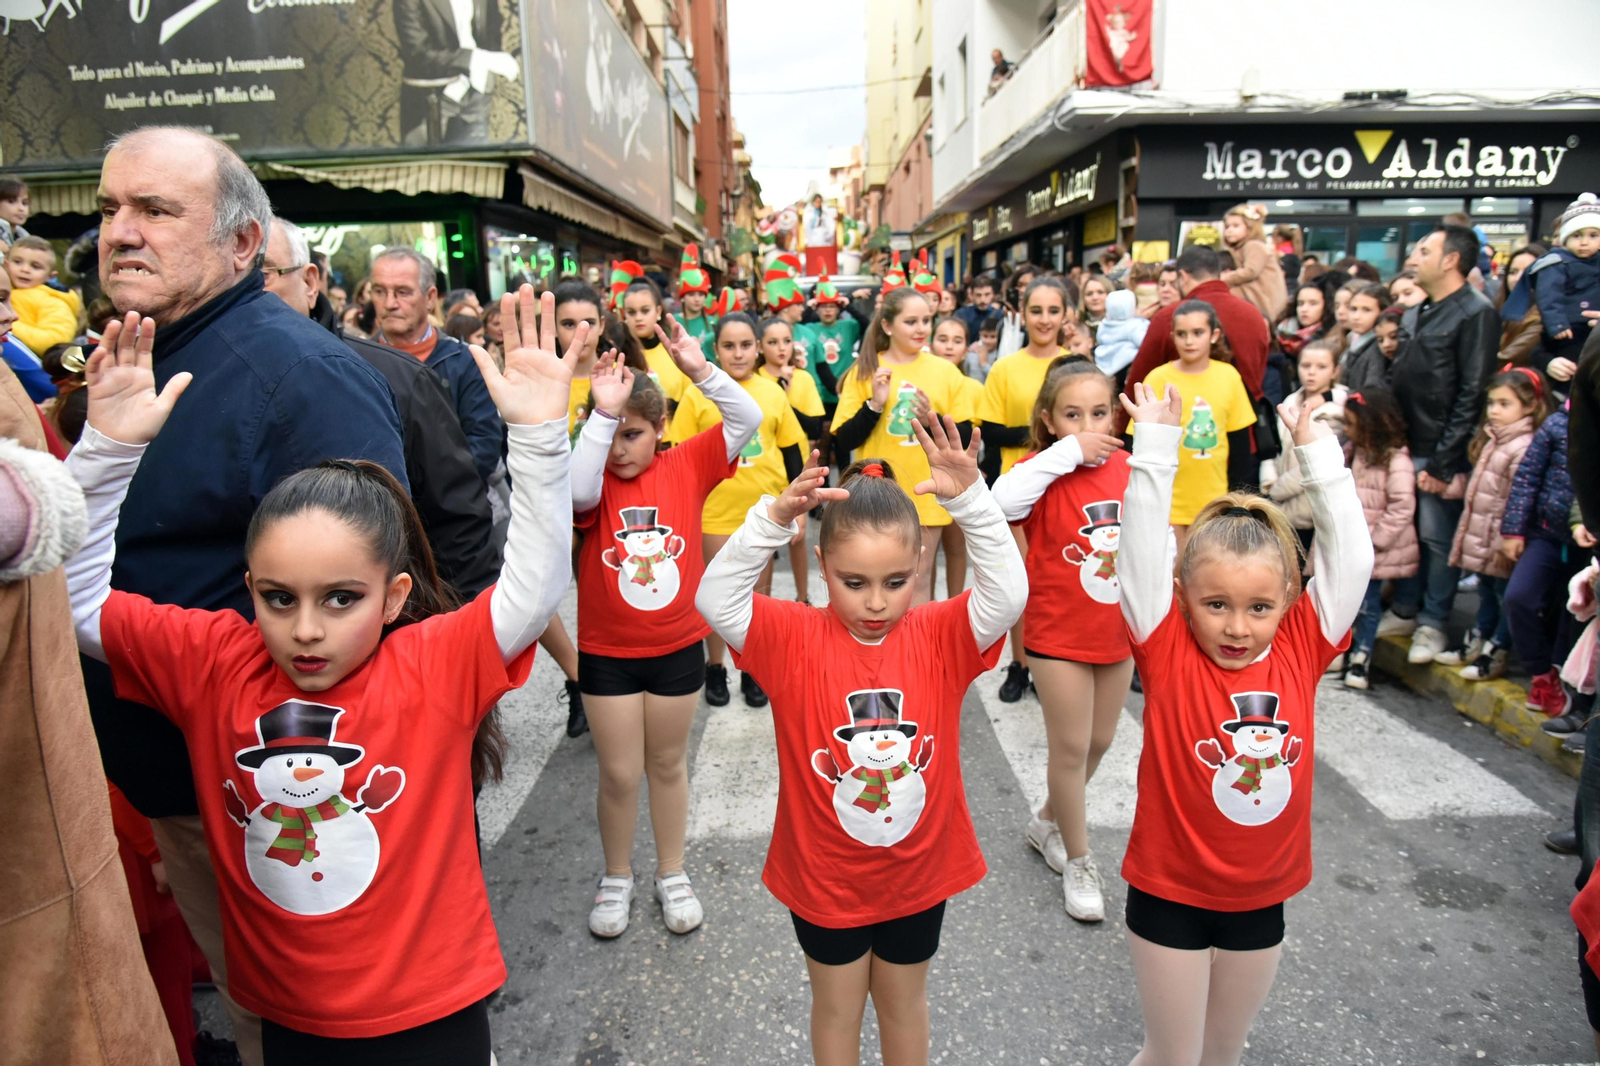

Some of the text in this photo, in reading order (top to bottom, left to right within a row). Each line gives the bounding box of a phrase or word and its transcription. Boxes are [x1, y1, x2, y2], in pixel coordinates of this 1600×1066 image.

[68, 55, 305, 82] Todo para el Novio, Padrino y Acompañantes
[104, 91, 147, 111] Alquiler
[148, 90, 163, 107] de
[205, 92, 213, 106] y
[213, 86, 250, 104] Media
[249, 84, 276, 102] Gala
[1202, 136, 1569, 186] Marco Aldany
[1400, 180, 1408, 189] Y
[1474, 178, 1490, 188] EN
